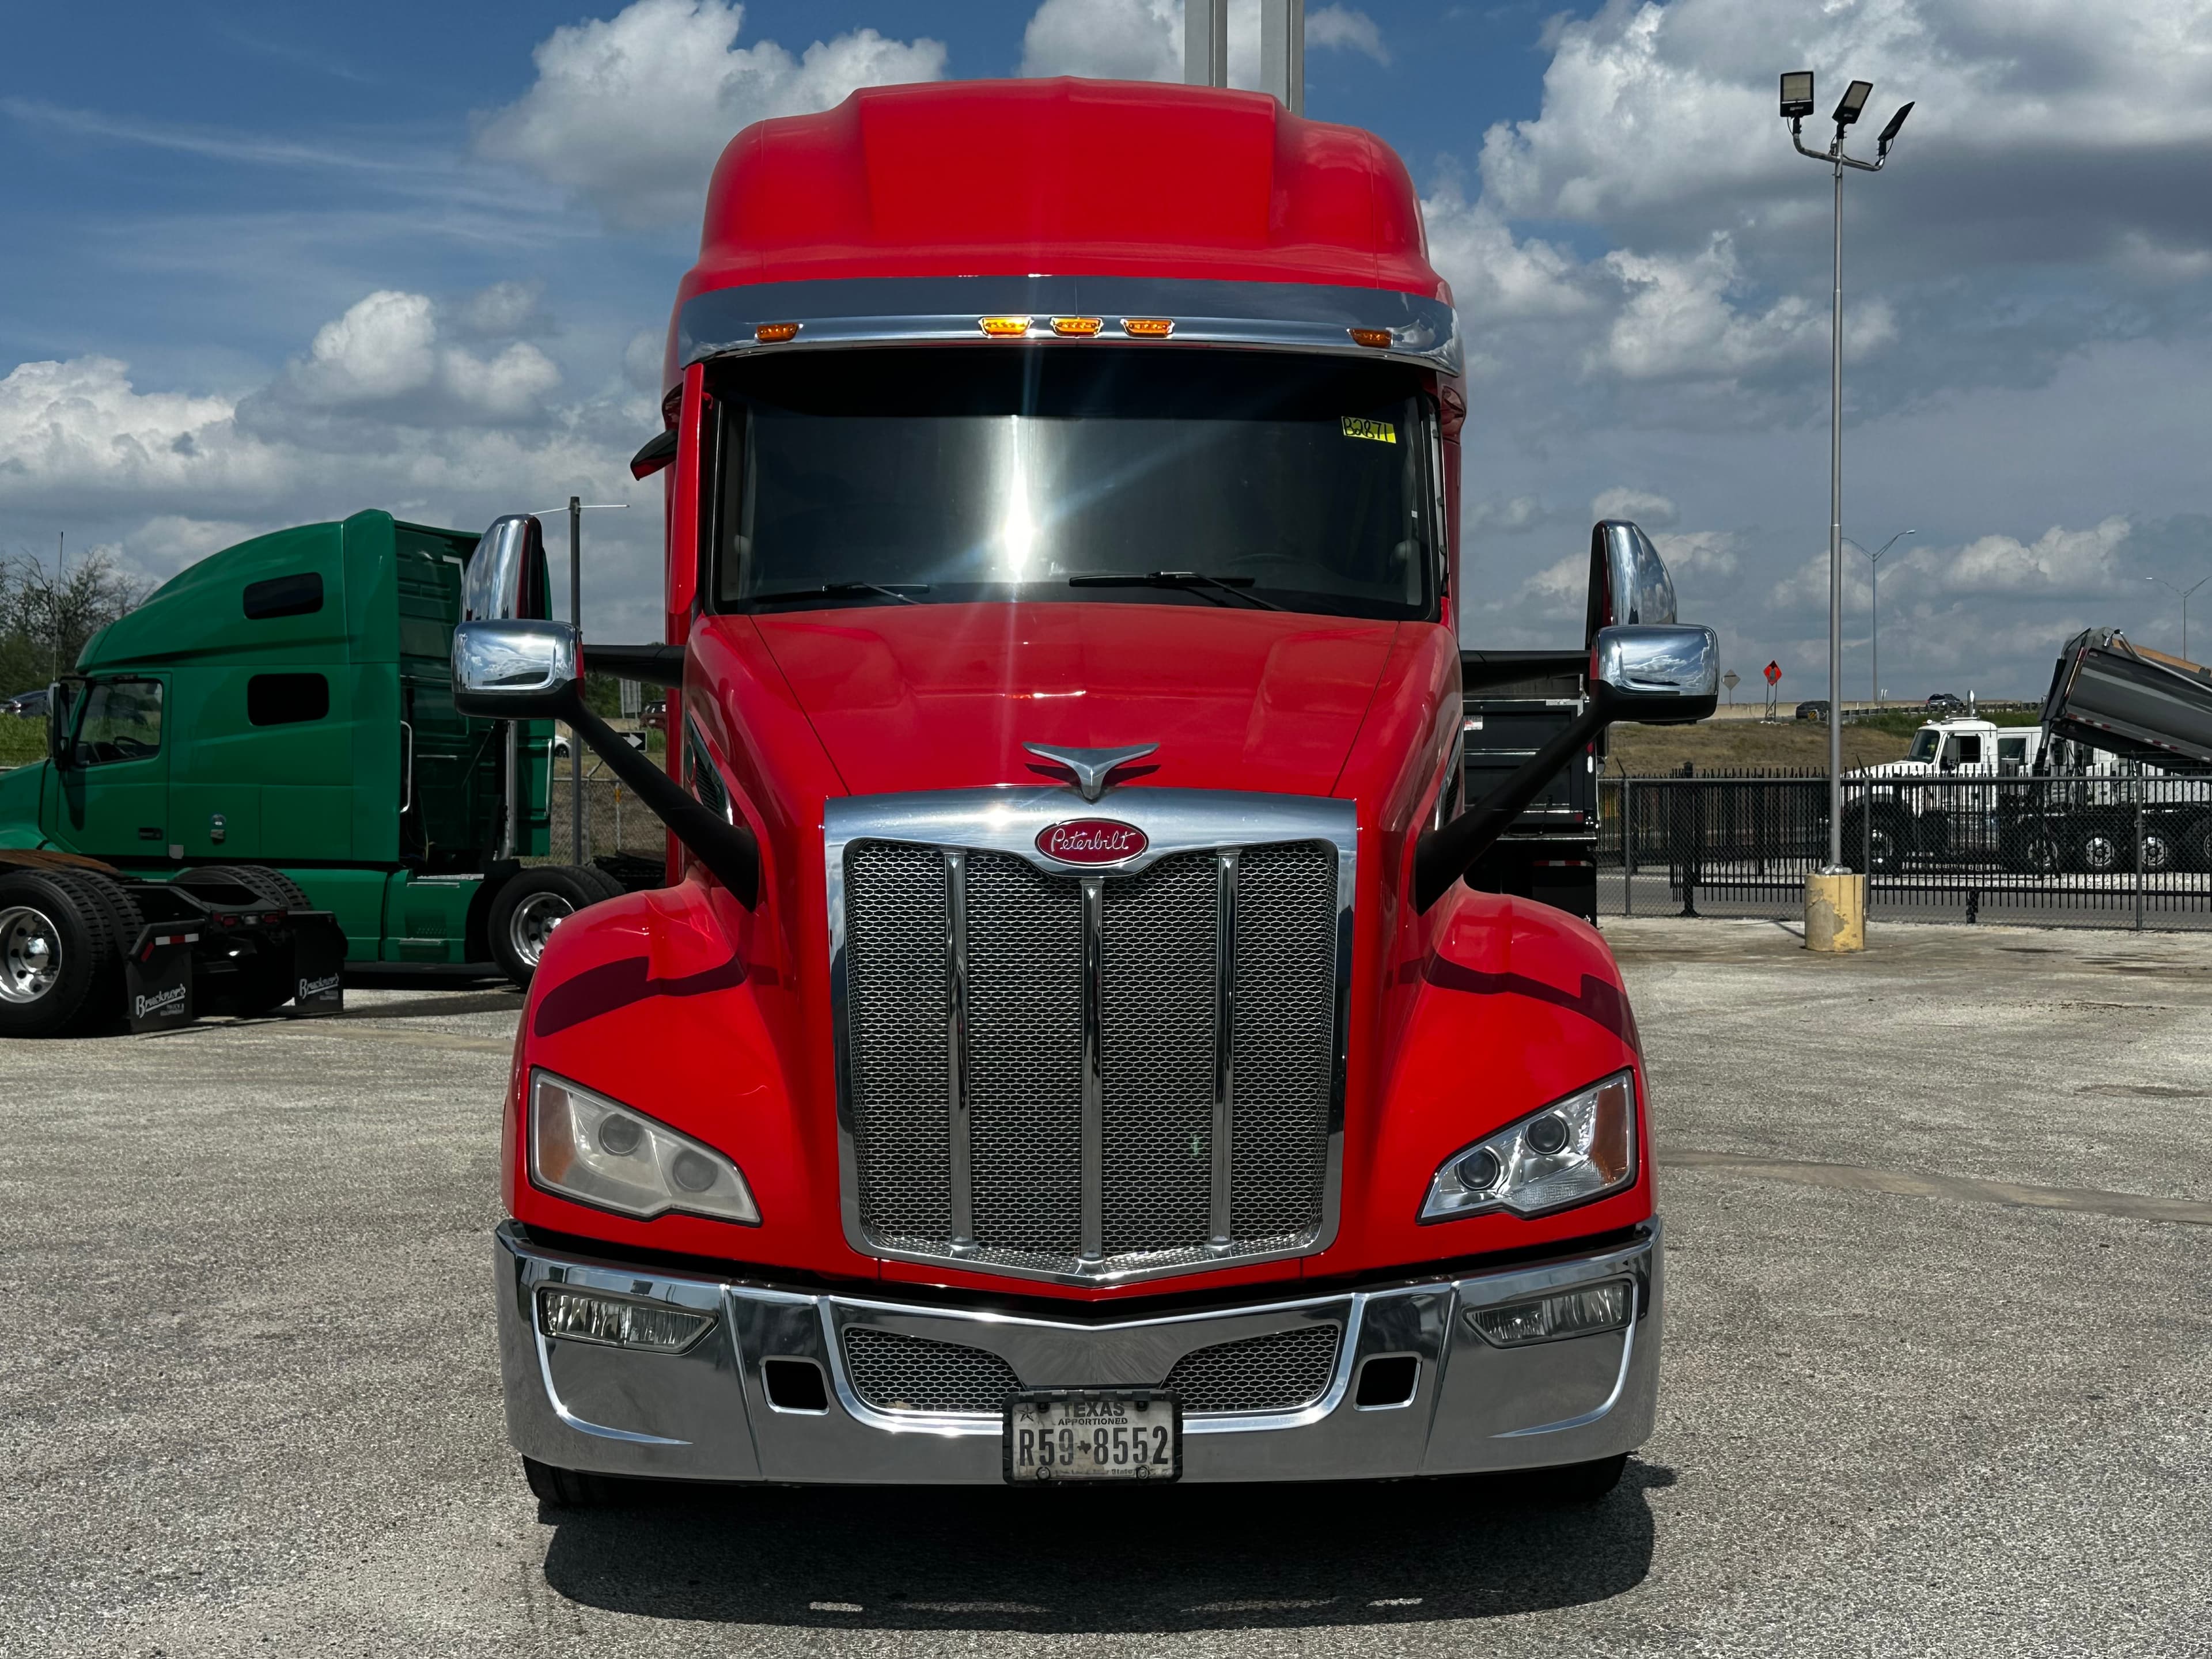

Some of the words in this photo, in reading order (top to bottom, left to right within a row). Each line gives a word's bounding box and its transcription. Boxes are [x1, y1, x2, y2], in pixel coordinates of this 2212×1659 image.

[1343, 416, 1388, 442] B2871
[1050, 828, 1136, 853] Peterbilt
[1058, 1418, 1128, 1426] APPORTIONED
[1061, 1401, 1125, 1418] TEXAS
[1019, 1429, 1074, 1467] R59
[1094, 1426, 1168, 1465] 8552
